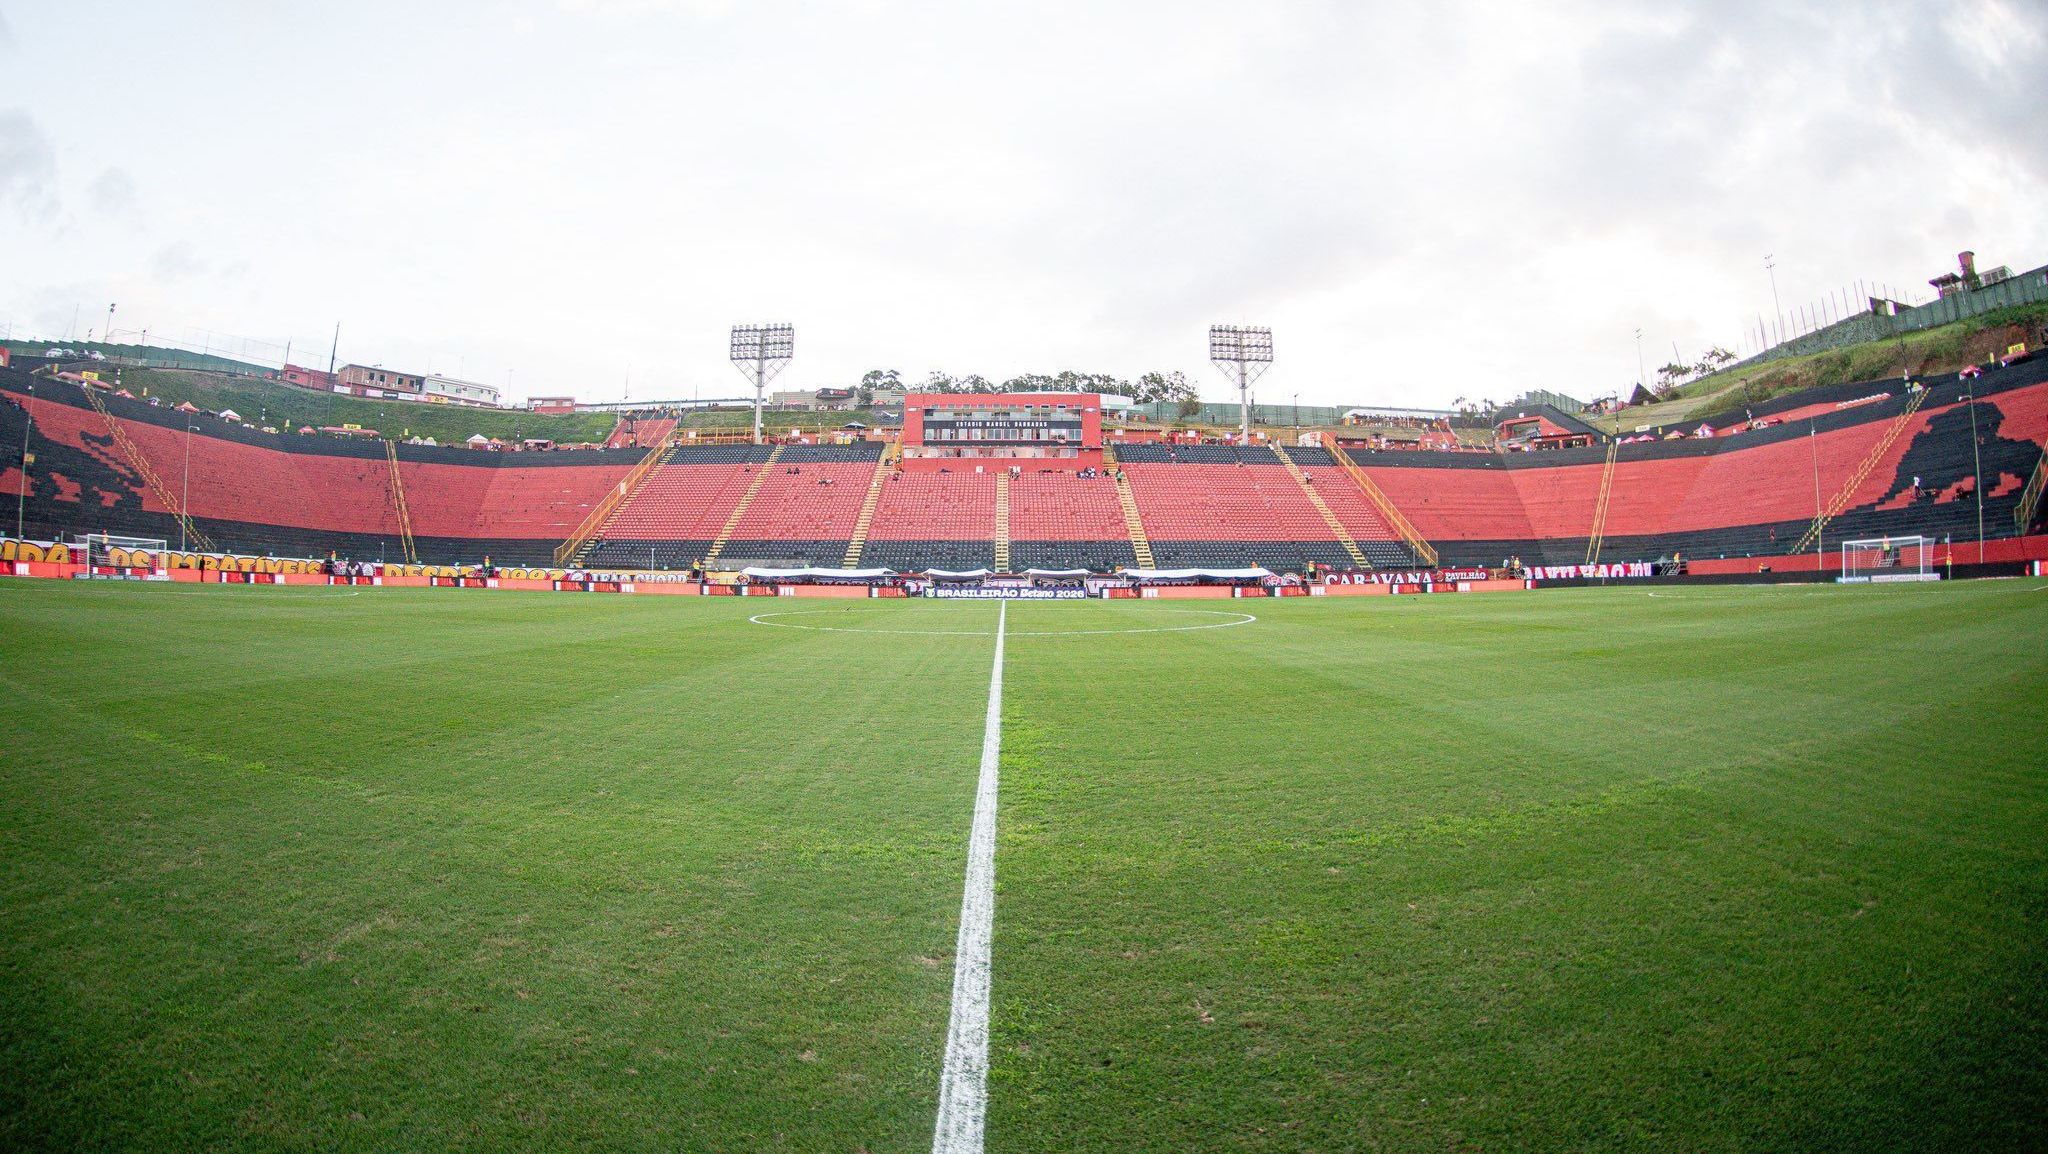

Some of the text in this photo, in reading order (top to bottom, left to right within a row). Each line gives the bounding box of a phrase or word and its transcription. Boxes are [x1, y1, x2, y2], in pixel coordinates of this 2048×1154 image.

[0, 540, 70, 564] IDA
[1325, 572, 1433, 585] CARAVANA
[937, 587, 1018, 598] BRASILEIRÃO
[1020, 588, 1054, 598] Betano
[1056, 589, 1085, 598] 2026
